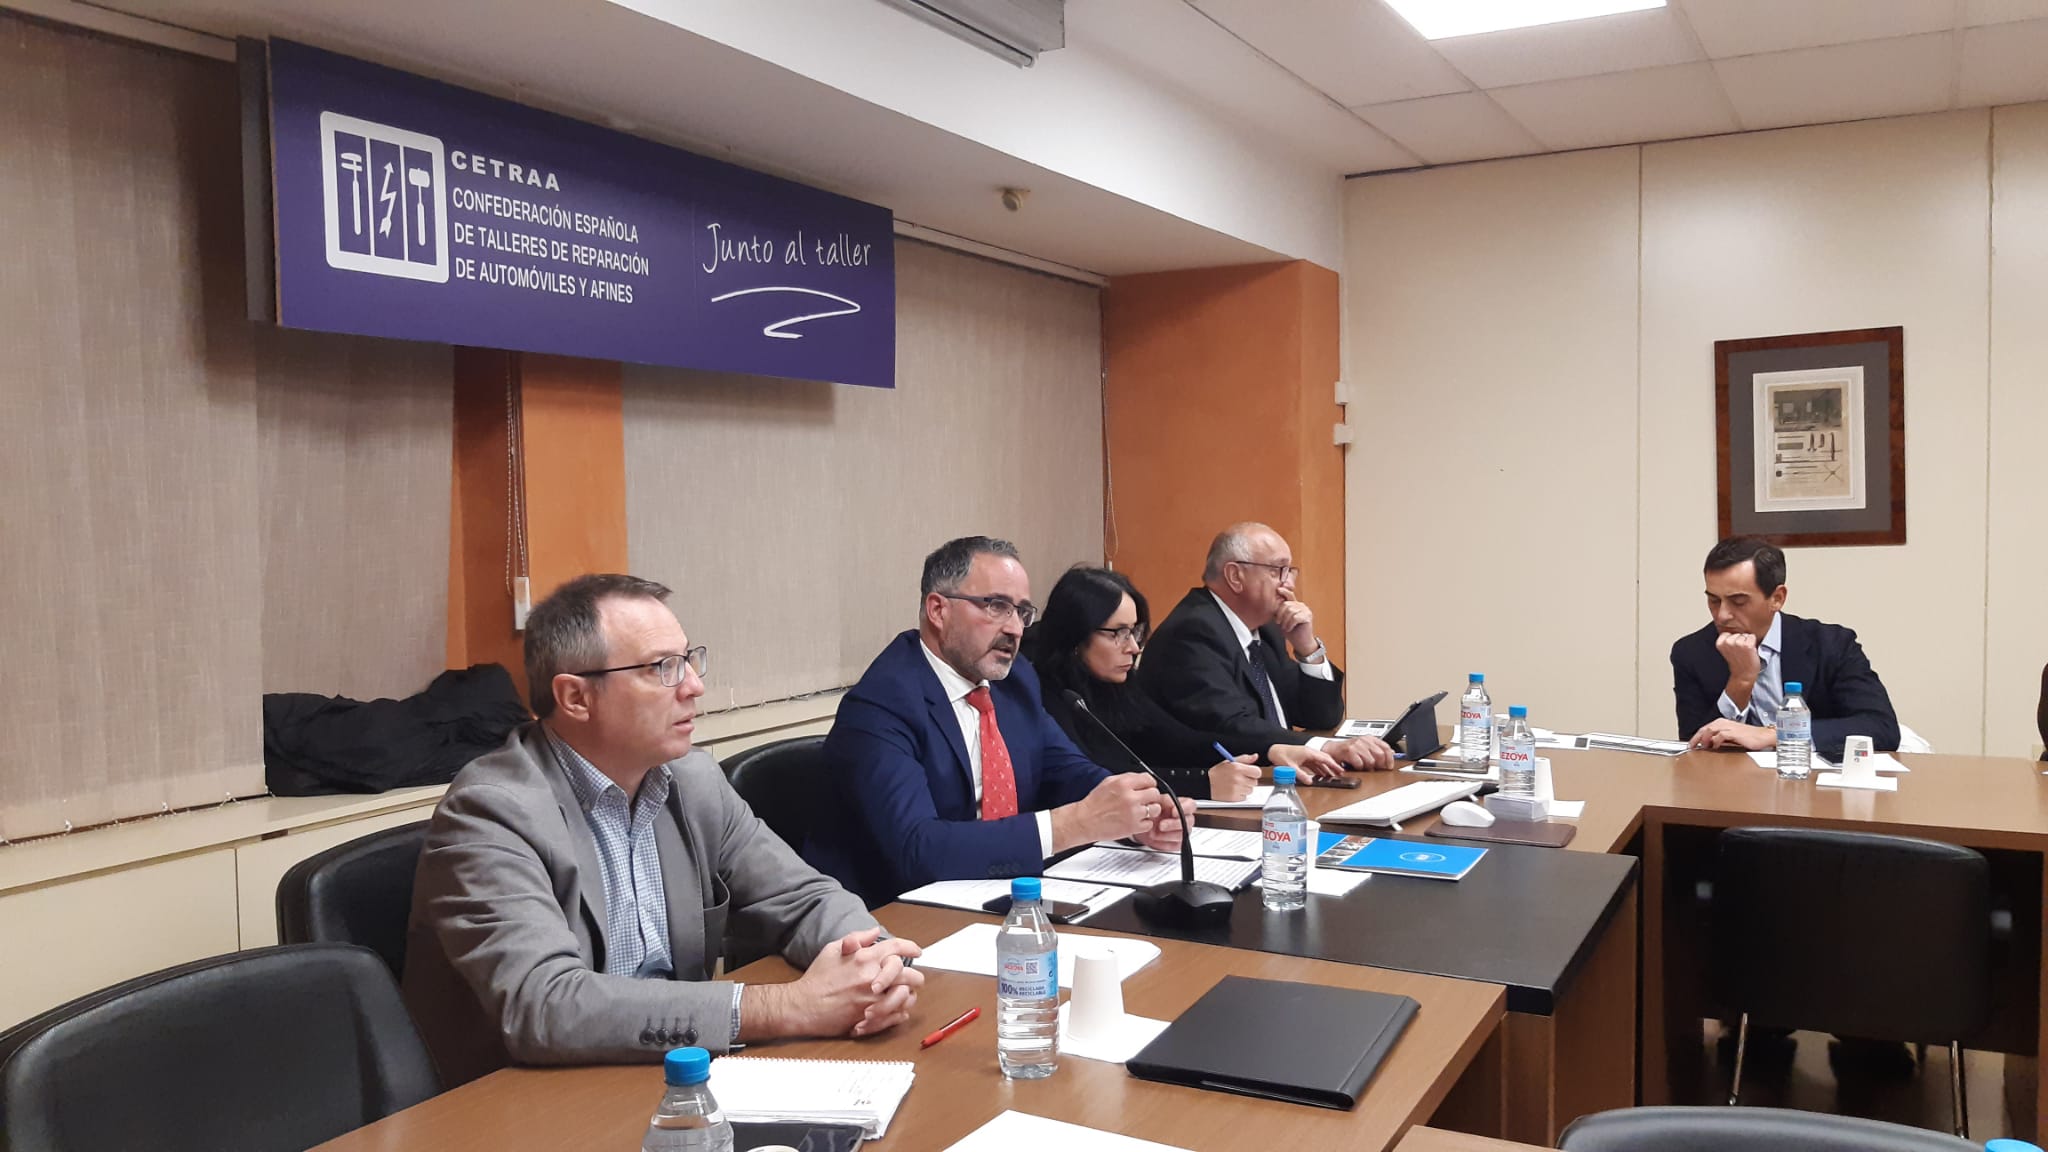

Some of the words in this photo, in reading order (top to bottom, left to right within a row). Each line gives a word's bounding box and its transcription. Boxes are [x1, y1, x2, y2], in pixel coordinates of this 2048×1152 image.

[451, 150, 560, 192] CETRAA
[453, 187, 571, 230] CONFEDERACIÓN
[575, 213, 639, 243] ESPAÑOLA
[454, 222, 475, 245] DE
[478, 226, 548, 258] TALLERES
[551, 240, 569, 262] DE
[572, 244, 649, 276] REPARACIÓN
[702, 223, 773, 273] Junto
[785, 230, 807, 265] al
[816, 233, 871, 266] taller
[455, 257, 476, 280] DE
[479, 262, 576, 295] AUTOMÓVILES
[578, 278, 588, 297] Y
[590, 280, 633, 304] AFINES
[1500, 751, 1528, 761] EZOYA
[1263, 829, 1291, 842] ZOYA
